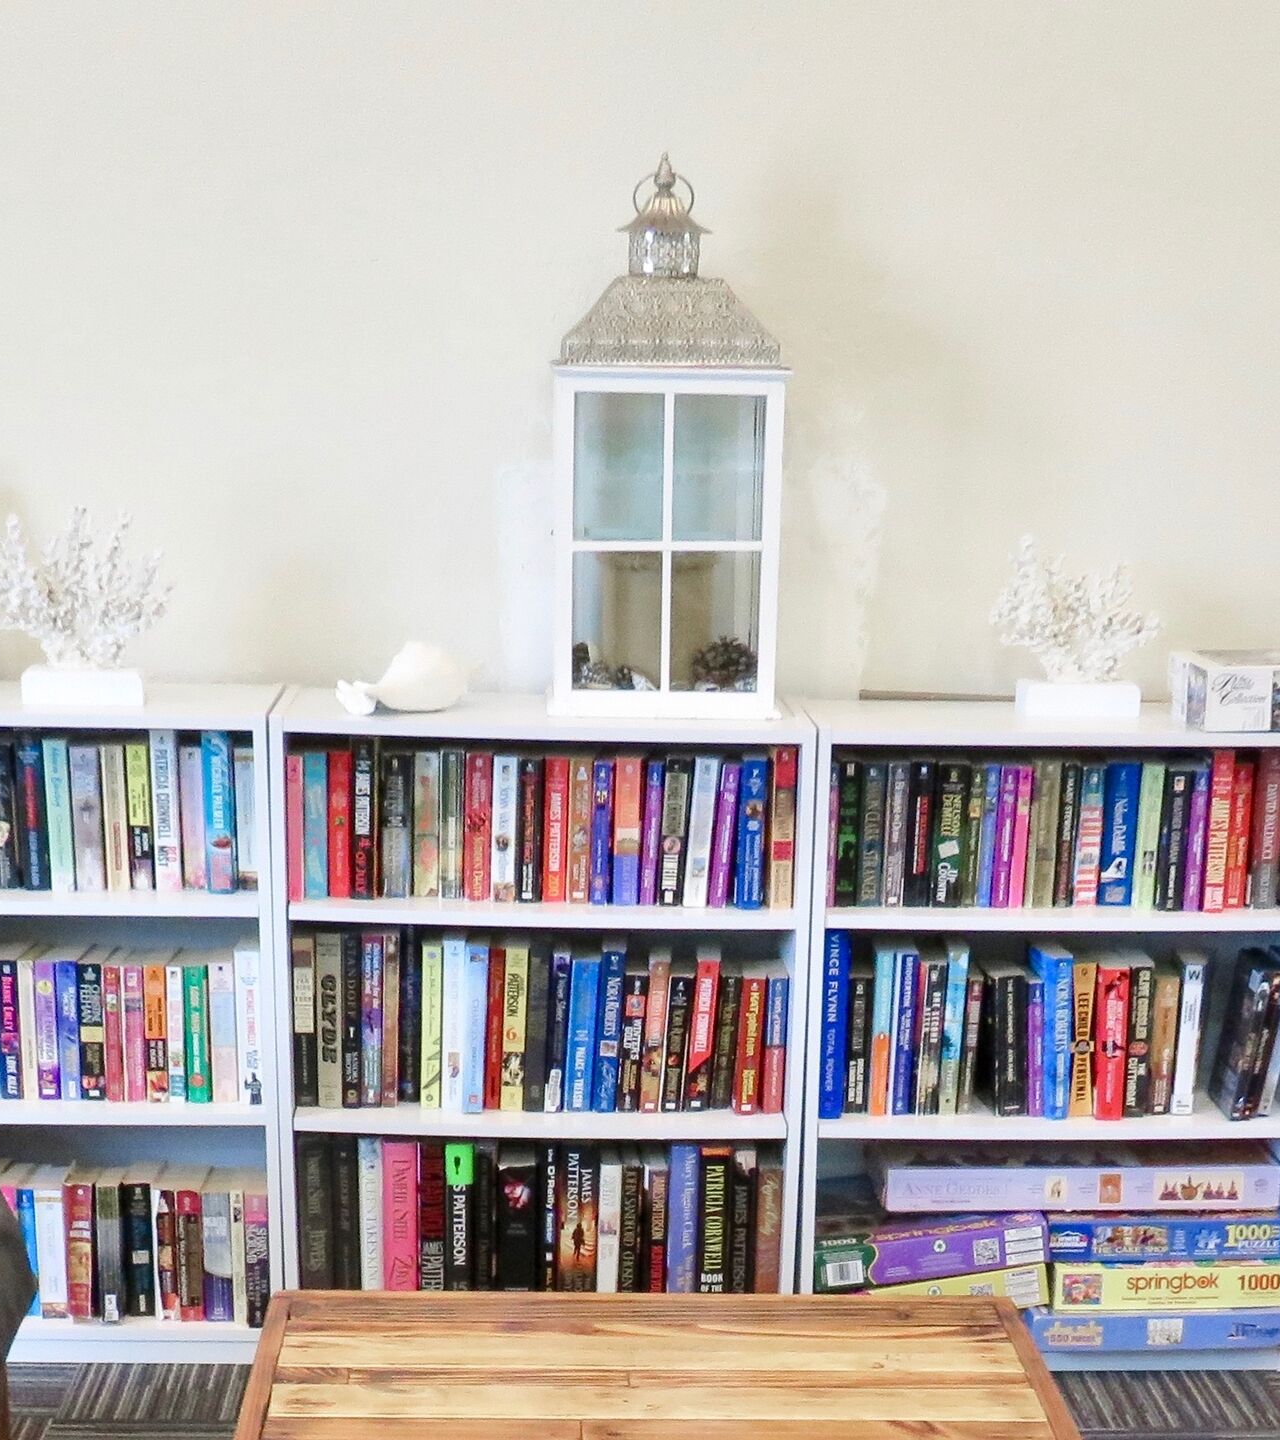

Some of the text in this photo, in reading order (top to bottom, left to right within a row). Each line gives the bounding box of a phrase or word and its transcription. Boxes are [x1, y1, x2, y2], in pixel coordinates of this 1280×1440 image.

[155, 748, 171, 839] PATRICIA CORNWELL
[212, 755, 224, 830] MICHAEL PALMER
[355, 771, 370, 795] JAMES
[355, 796, 370, 836] PATTERSON
[951, 794, 961, 837] NELSON
[1063, 778, 1074, 841] MARY STEWART
[1261, 784, 1279, 861] DAVID BALDACCI
[157, 846, 169, 868] MIST
[548, 792, 562, 896] JAMES PATTERSON ZOO
[1208, 797, 1231, 884] JAMES PATTERSON
[355, 868, 366, 894] JULY
[472, 836, 484, 896] SUDDEN DEATH
[861, 849, 879, 902] STRANGER
[937, 862, 949, 904] COUNTRY
[947, 868, 959, 884] UP
[1, 976, 15, 1004] DIANNE
[346, 941, 358, 1018] STANDOFF
[506, 973, 519, 1017] PATTERSON
[904, 955, 914, 1008] BRIDGERTON
[80, 984, 94, 1024] FEEHAN
[246, 988, 256, 1015] MICHAEL
[603, 976, 621, 1037] NORA ROBERTS
[694, 978, 712, 1054] PATRICIA CORNWELL
[824, 934, 841, 1092] VINCE FLYNN TOTAL POWER
[929, 991, 941, 1043] ONE SECOND
[1055, 978, 1070, 1053] NORA ROBERTS
[1135, 969, 1151, 1040] CLIVE CUSSLER
[623, 1026, 631, 1049] GOLD
[630, 1018, 642, 1060] WINTER'S
[1006, 978, 1015, 1082] THE FOUNTAINHEAD AYN RAND
[1075, 992, 1090, 1102] LEE CHILD PERSONAL
[6, 1055, 17, 1073] LOVE
[351, 1051, 359, 1084] SANDRA
[573, 1046, 585, 1108] PALACE TREASON
[1126, 1057, 1139, 1107] CUTTHROAT
[1139, 1062, 1147, 1076] THE
[7, 1074, 18, 1095] KILLS
[391, 1160, 412, 1203] DANIELLE
[567, 1152, 579, 1220] PATTERSON
[580, 1168, 593, 1204] JAMES
[652, 1175, 665, 1198] JAMES
[683, 1152, 696, 1181] Mary
[545, 1165, 556, 1209] O'Reilly
[680, 1181, 696, 1220] Higgins
[734, 1186, 748, 1224] JAMES
[903, 1181, 1001, 1196] ANNE GEDDES
[366, 1217, 378, 1256] TAKES
[392, 1209, 412, 1244] STEEL
[452, 1194, 466, 1265] PATTERSON
[545, 1212, 554, 1242] factor
[621, 1171, 639, 1288] JOHN SANDFORD CHOSEN
[651, 1198, 665, 1240] PATTERSON
[681, 1220, 694, 1249] Clark
[703, 1165, 725, 1271] PATRICIA CORNWELL
[875, 1220, 998, 1242] springbok
[1223, 1223, 1272, 1249] 1000
[179, 1240, 187, 1265] TAYLOR
[255, 1227, 268, 1260] SHARYN
[820, 1237, 857, 1248] 1000
[1093, 1245, 1111, 1255] THE
[1115, 1245, 1141, 1254] CAKE
[1237, 1238, 1280, 1248] PUZZLE
[180, 1266, 188, 1306] ROSENBERG
[700, 1273, 724, 1283] BOOK
[701, 1284, 723, 1293] OF THE
[1126, 1273, 1220, 1295] springbok
